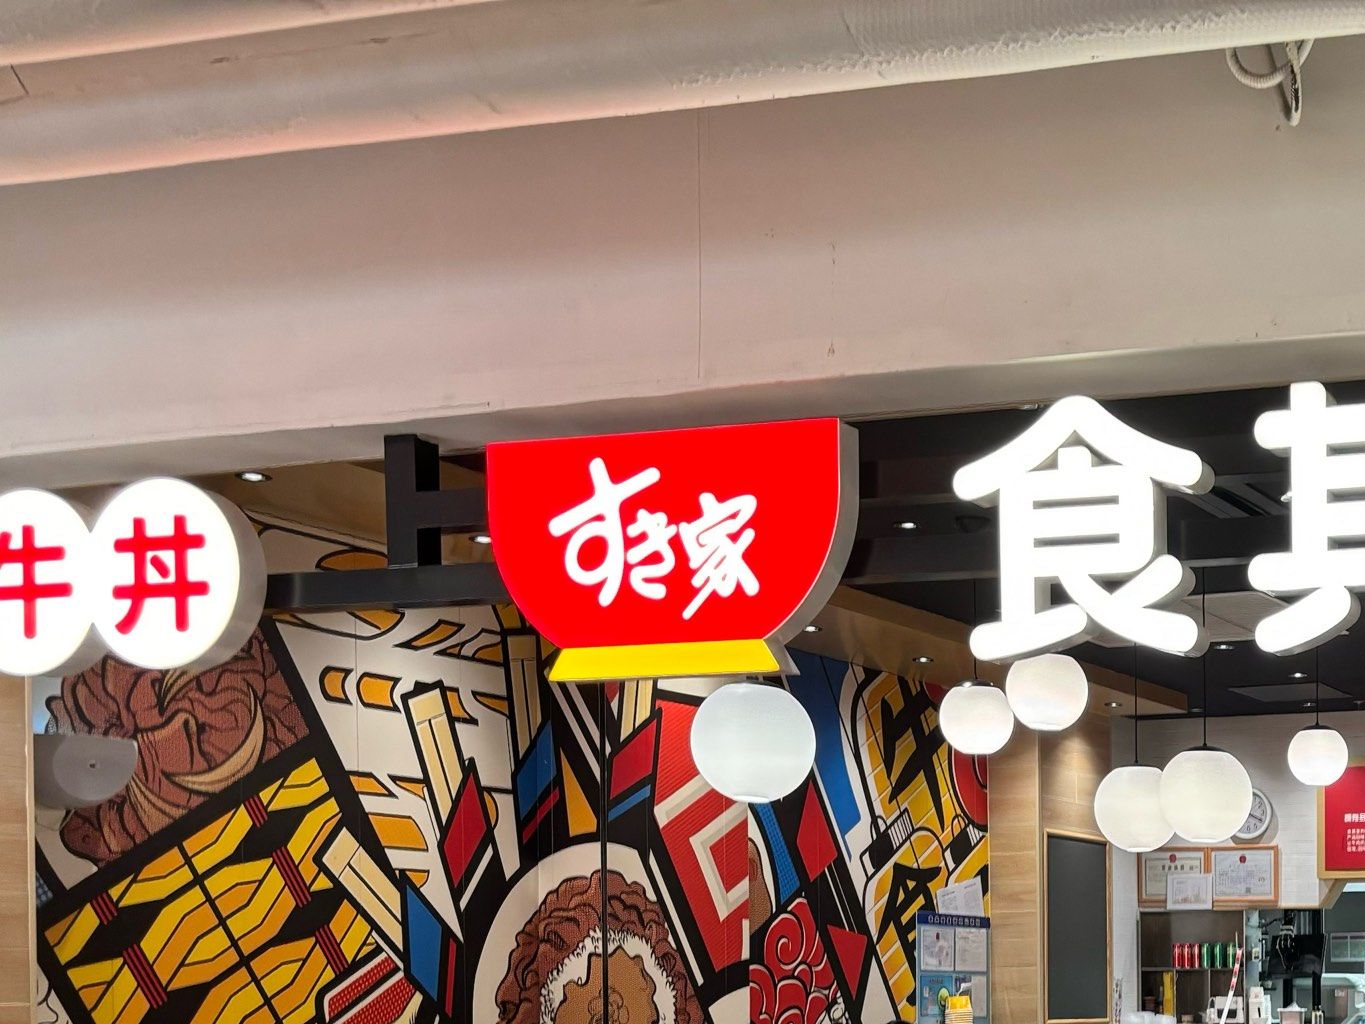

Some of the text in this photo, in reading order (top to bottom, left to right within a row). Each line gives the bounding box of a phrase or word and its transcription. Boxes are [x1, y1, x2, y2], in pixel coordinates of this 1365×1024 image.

[0, 514, 211, 639] 牛丼
[548, 456, 762, 620] すき家
